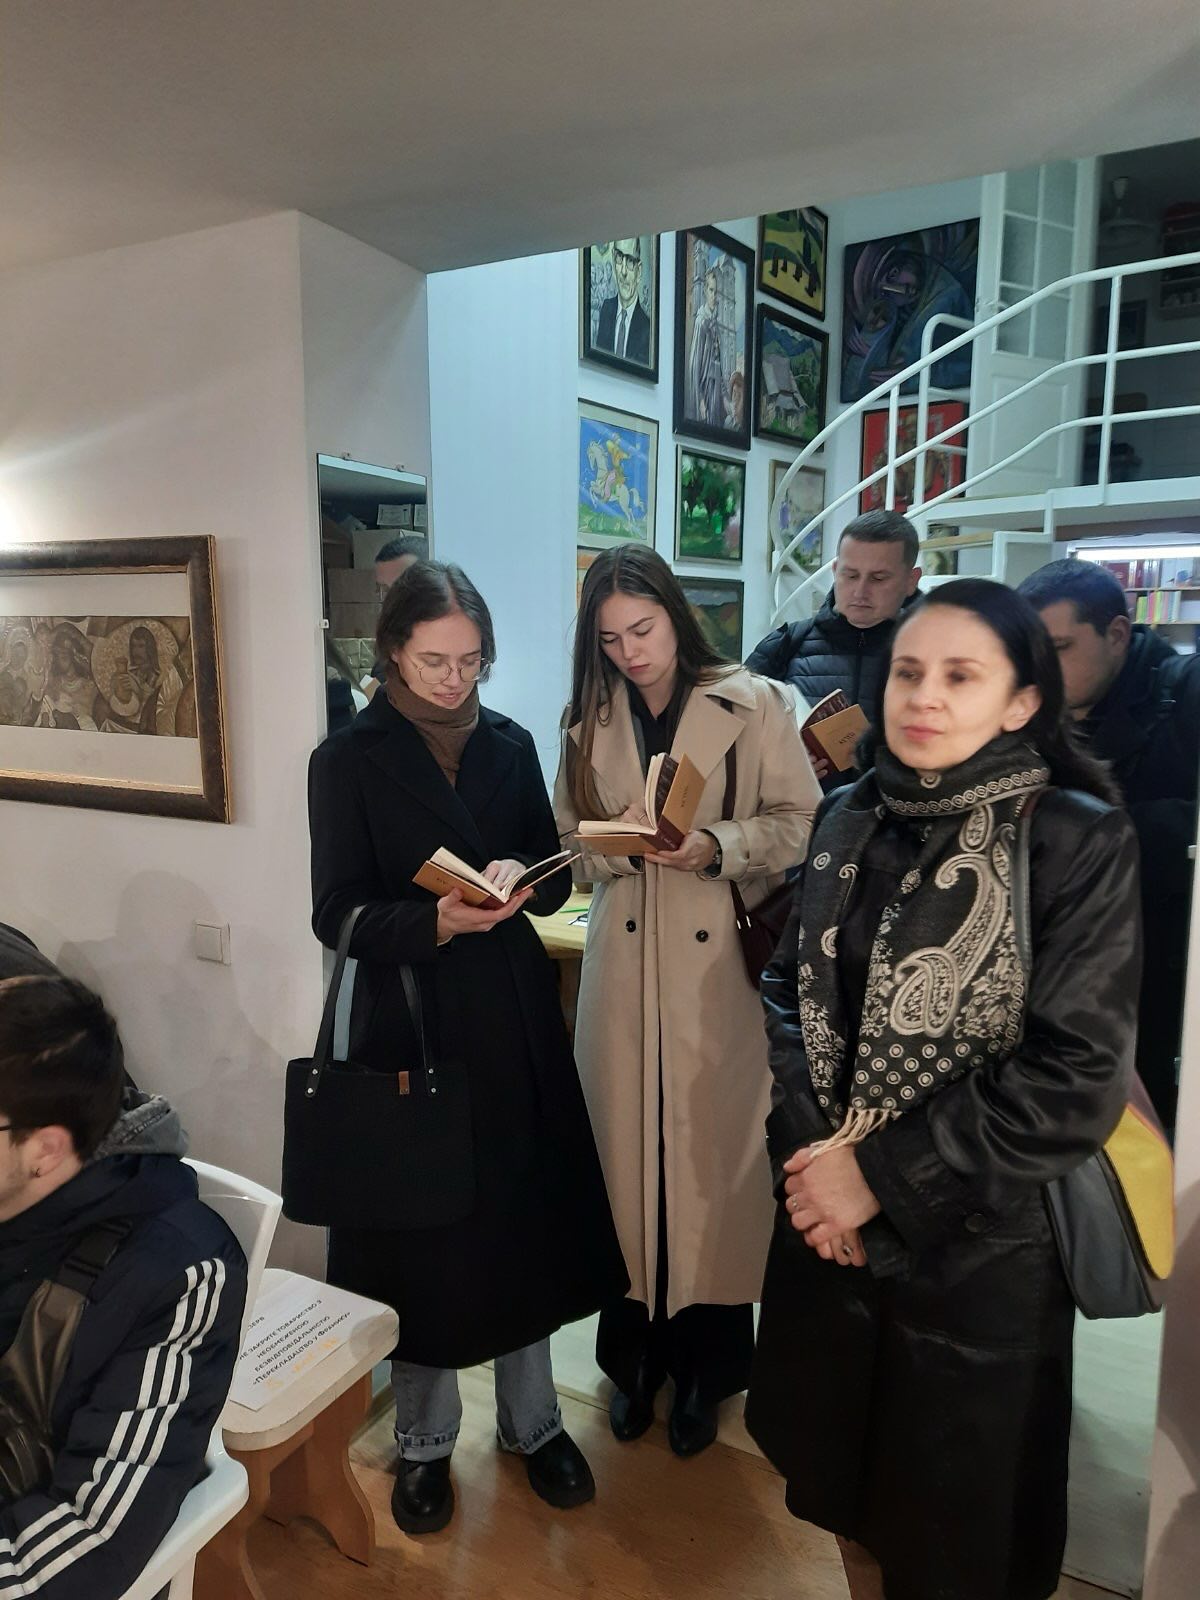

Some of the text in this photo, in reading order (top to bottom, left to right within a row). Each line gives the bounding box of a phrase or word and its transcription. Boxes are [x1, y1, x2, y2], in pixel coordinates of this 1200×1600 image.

[248, 1330, 277, 1352] ЗАКРИТЕ
[277, 1303, 317, 1332] ТОВАРИСТВО
[254, 1316, 330, 1372] БЕЗВІДПОВІДАЛЬНІСТЮ
[257, 1320, 309, 1358] НЕОБМЕЖЕНОЮ
